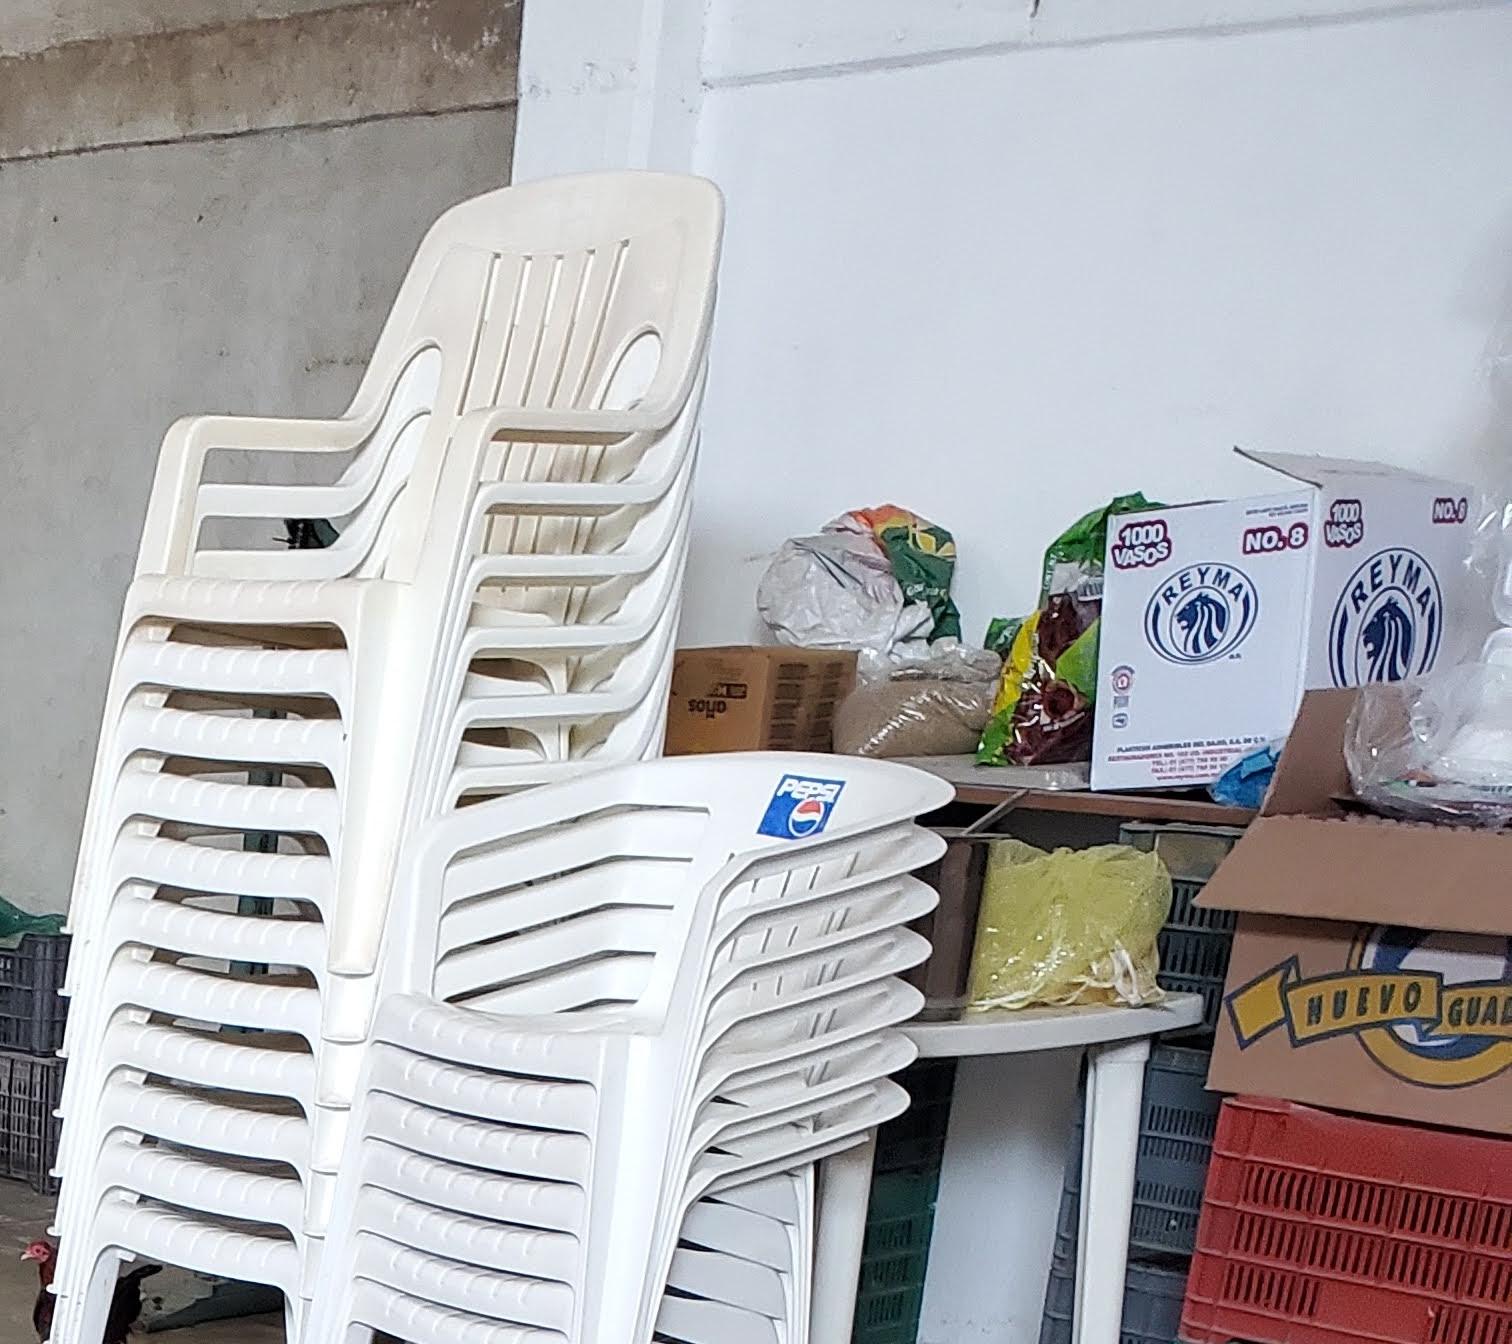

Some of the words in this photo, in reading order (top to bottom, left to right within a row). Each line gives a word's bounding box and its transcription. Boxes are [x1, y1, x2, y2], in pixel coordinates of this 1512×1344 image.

[1331, 502, 1360, 522] 1000
[1433, 501, 1455, 520] NO.
[1121, 525, 1164, 547] 1000
[1245, 530, 1284, 552] NO.
[1289, 526, 1305, 547] 8
[1326, 523, 1362, 544] VASOS
[1113, 541, 1169, 566] VASOS
[1161, 566, 1244, 606] REYMA
[1350, 554, 1432, 617] REYMA
[775, 777, 842, 803] PEPSI
[1306, 980, 1422, 1027] NUEVO
